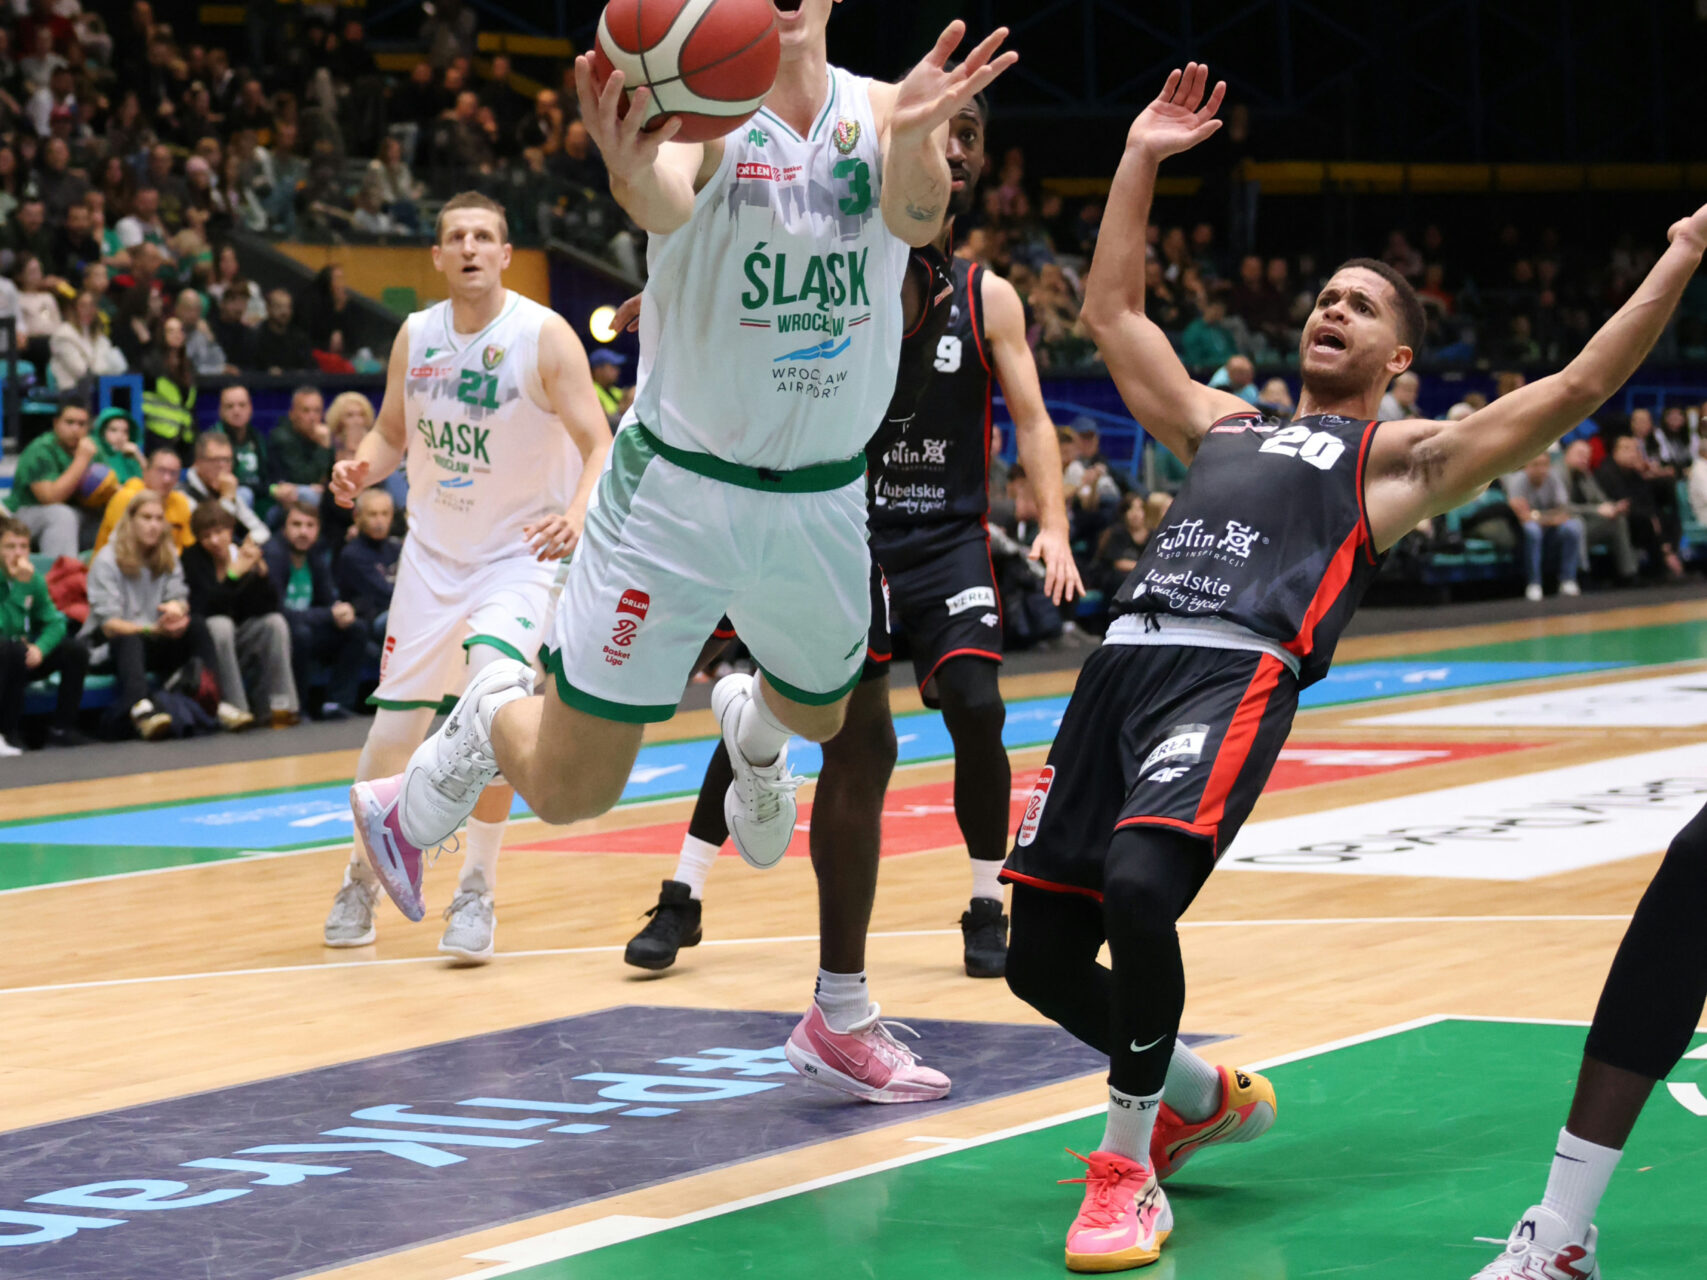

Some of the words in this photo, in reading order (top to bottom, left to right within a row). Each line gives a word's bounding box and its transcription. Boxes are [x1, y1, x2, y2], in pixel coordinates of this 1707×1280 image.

[736, 165, 771, 177] ORLEN
[832, 157, 872, 216] 3
[741, 241, 871, 312] ŚLĄSK
[777, 312, 845, 337] WROCŁW
[933, 335, 963, 373] 9
[457, 369, 500, 410] 21
[772, 366, 848, 386] WROCAW
[776, 381, 840, 399] AIRPORT
[1258, 425, 1346, 471] 20
[1144, 568, 1231, 597] lubelskie
[622, 597, 648, 610] ORLEN
[603, 645, 630, 660] Basket
[1142, 738, 1191, 769] ERŁA
[1147, 766, 1191, 783] 4F
